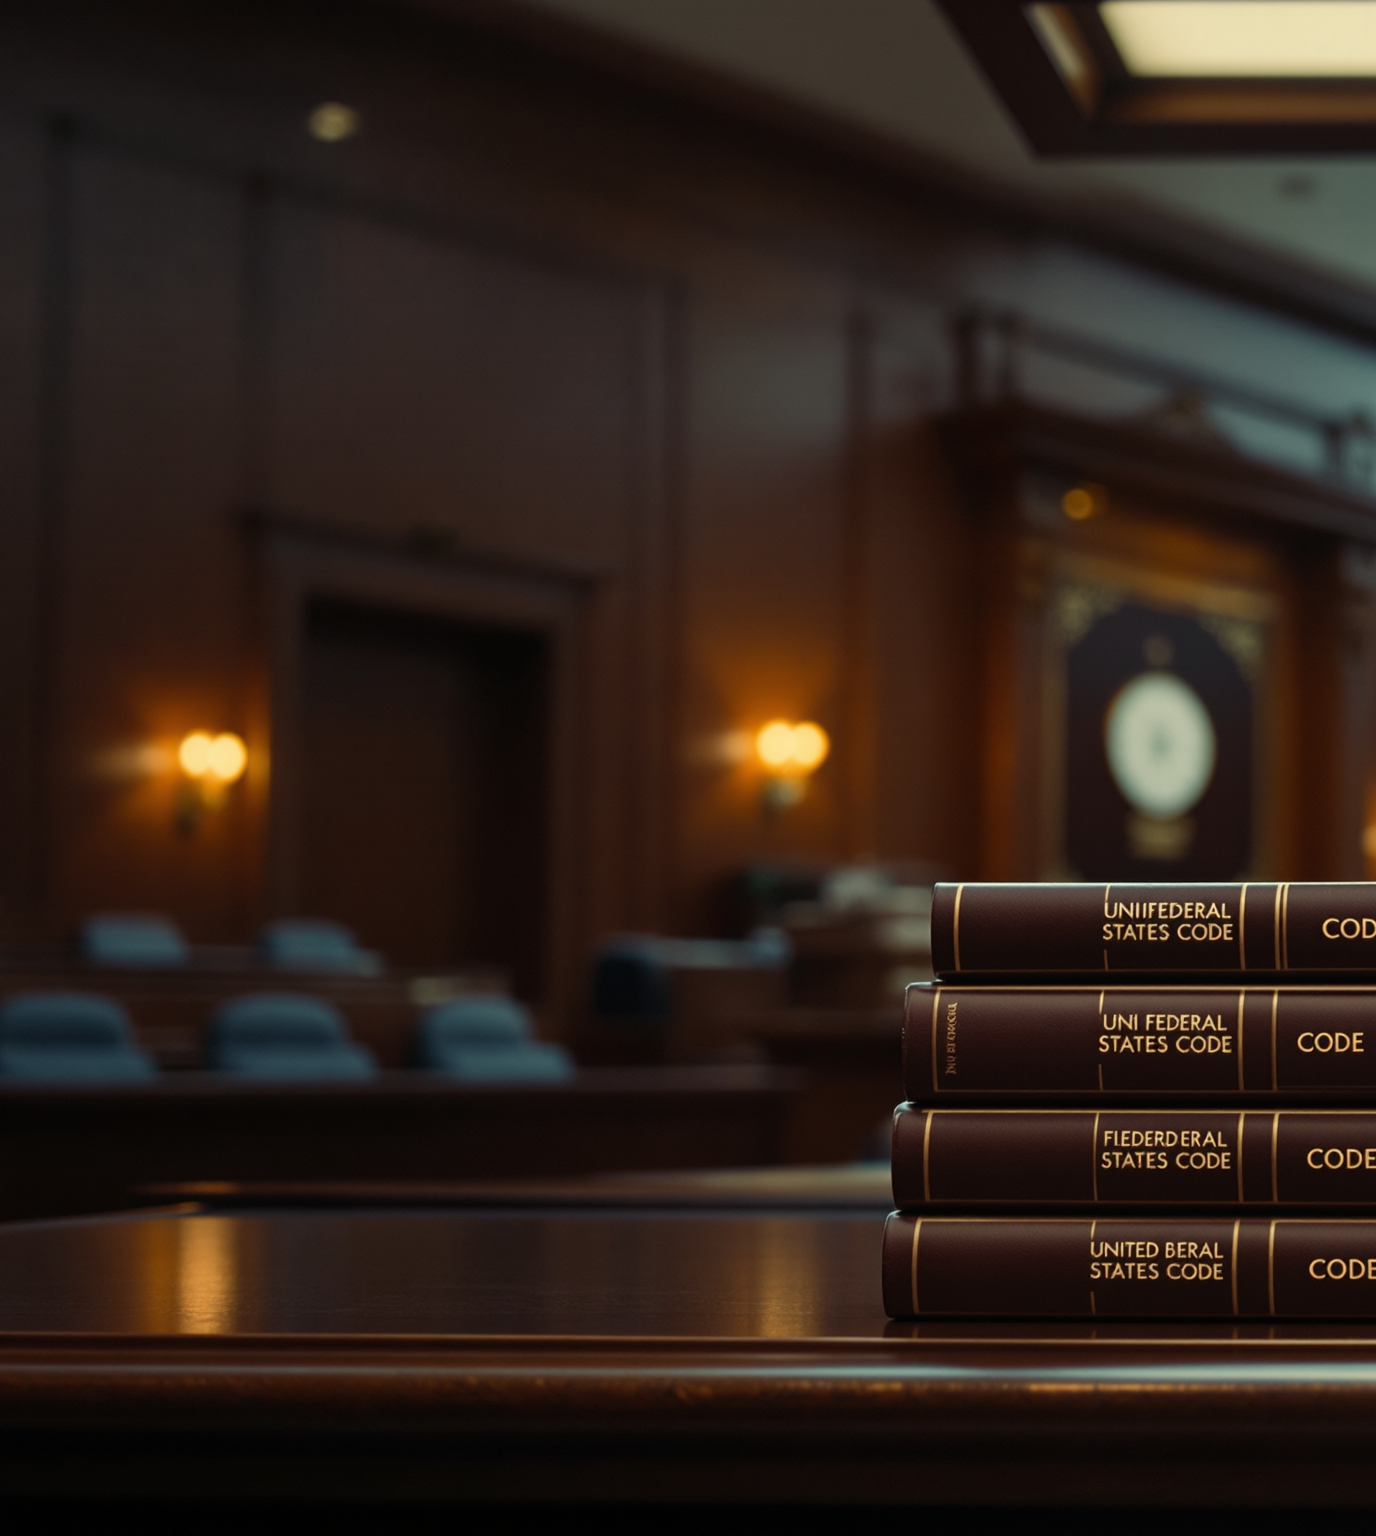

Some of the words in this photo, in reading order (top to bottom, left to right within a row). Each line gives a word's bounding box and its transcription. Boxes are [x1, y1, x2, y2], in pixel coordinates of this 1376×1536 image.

[1102, 923, 1170, 941] STATES
[1176, 922, 1234, 941] CODE
[1103, 1013, 1139, 1031] UNI
[1145, 1013, 1228, 1032] FEDERAL
[1098, 1034, 1169, 1054] STATES
[1175, 1035, 1233, 1054] CODE
[1297, 1031, 1365, 1053] CODE
[1101, 1151, 1168, 1170] STATES
[1175, 1151, 1231, 1170] CODE
[1090, 1241, 1160, 1259] UNITED
[1164, 1241, 1224, 1260] BERAL
[1090, 1261, 1160, 1280] STATES
[1166, 1262, 1224, 1281] CODE
